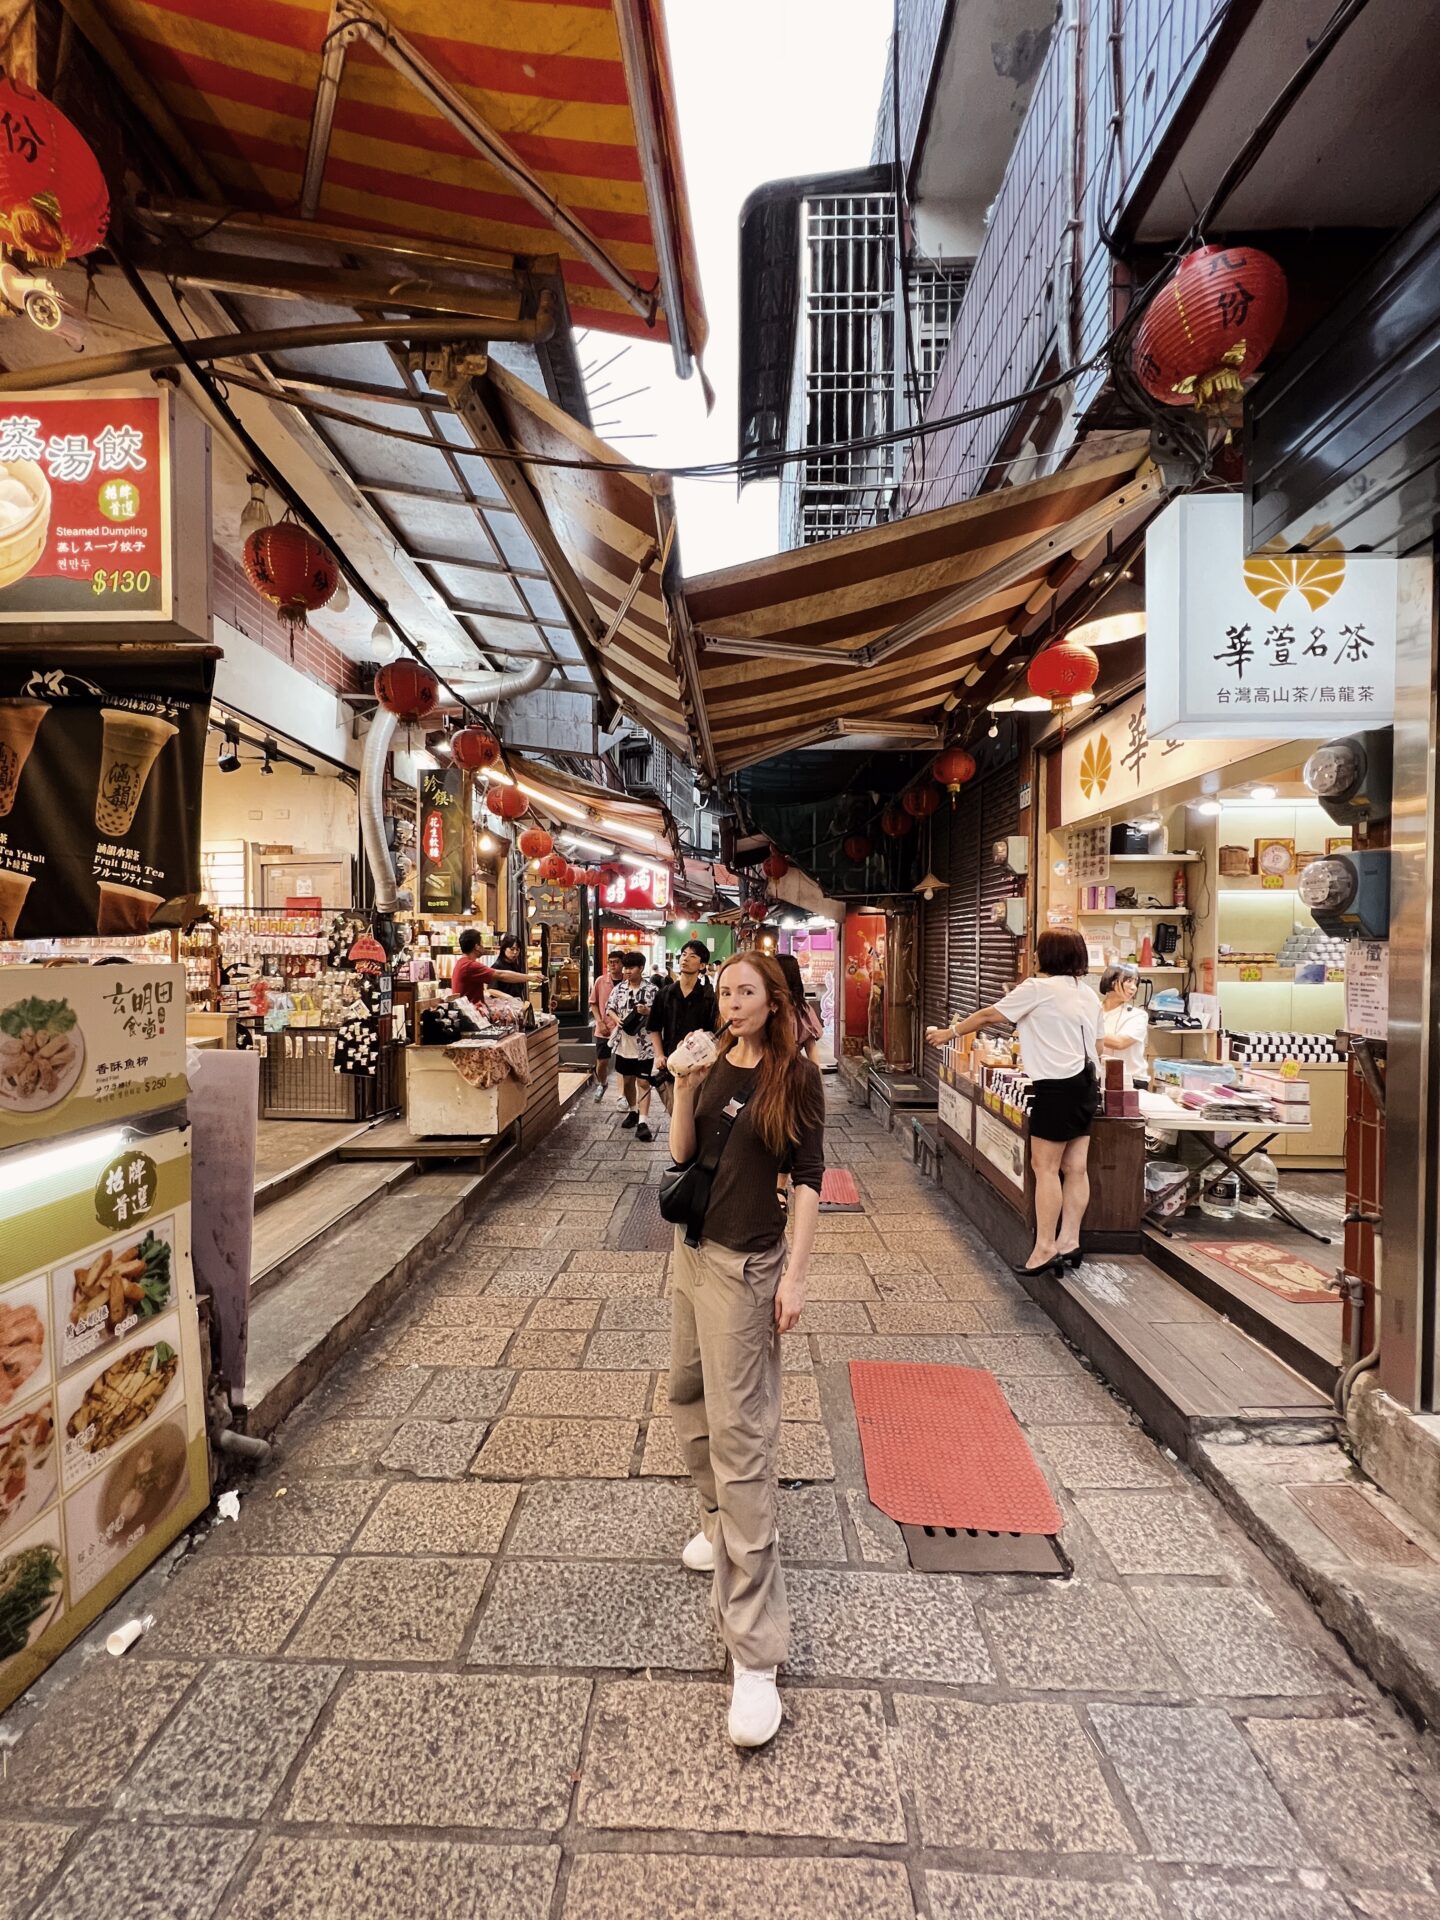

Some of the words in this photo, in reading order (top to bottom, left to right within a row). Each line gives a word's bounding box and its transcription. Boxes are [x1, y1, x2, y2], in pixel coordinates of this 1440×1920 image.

[1208, 252, 1256, 330] 九份
[56, 527, 99, 536] Steamed
[101, 526, 148, 538] Dumpling
[92, 568, 151, 595] $130
[1213, 622, 1376, 680] 華萱名茶
[1216, 685, 1376, 704] 台灣高山茶/烏龍茶
[94, 855, 119, 868] Fruit
[121, 861, 142, 873] Black
[145, 866, 165, 879] Tea
[106, 1158, 147, 1195] 招牌
[113, 1187, 152, 1222] 首選
